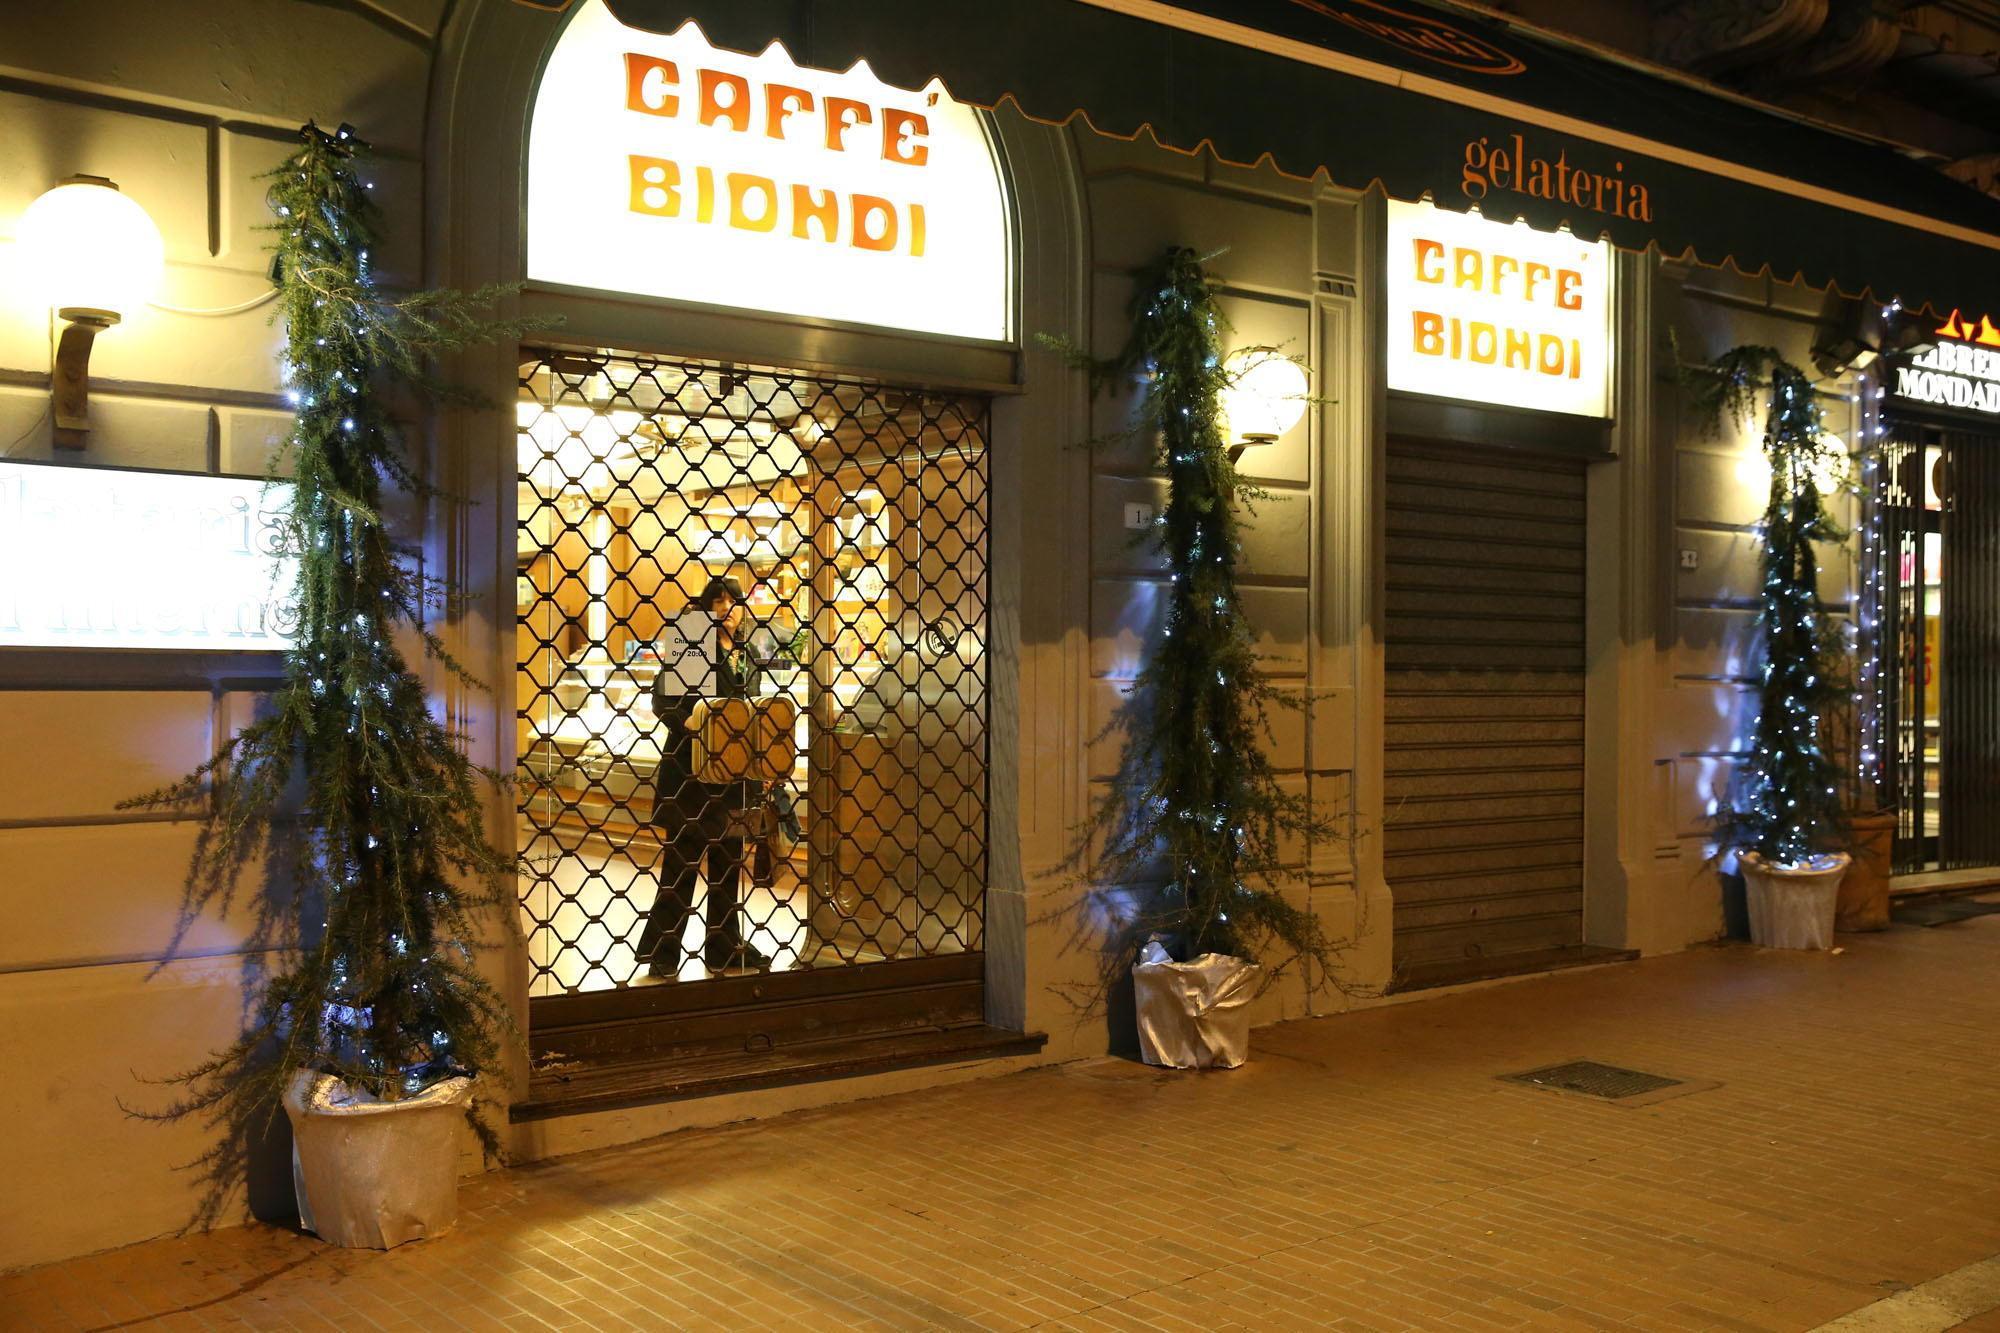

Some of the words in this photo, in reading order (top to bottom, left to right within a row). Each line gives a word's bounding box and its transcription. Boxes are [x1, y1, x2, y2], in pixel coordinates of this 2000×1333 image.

[628, 154, 926, 257] BIONDI
[1462, 134, 1653, 222] gelateria
[1413, 310, 1581, 380] BIONDI
